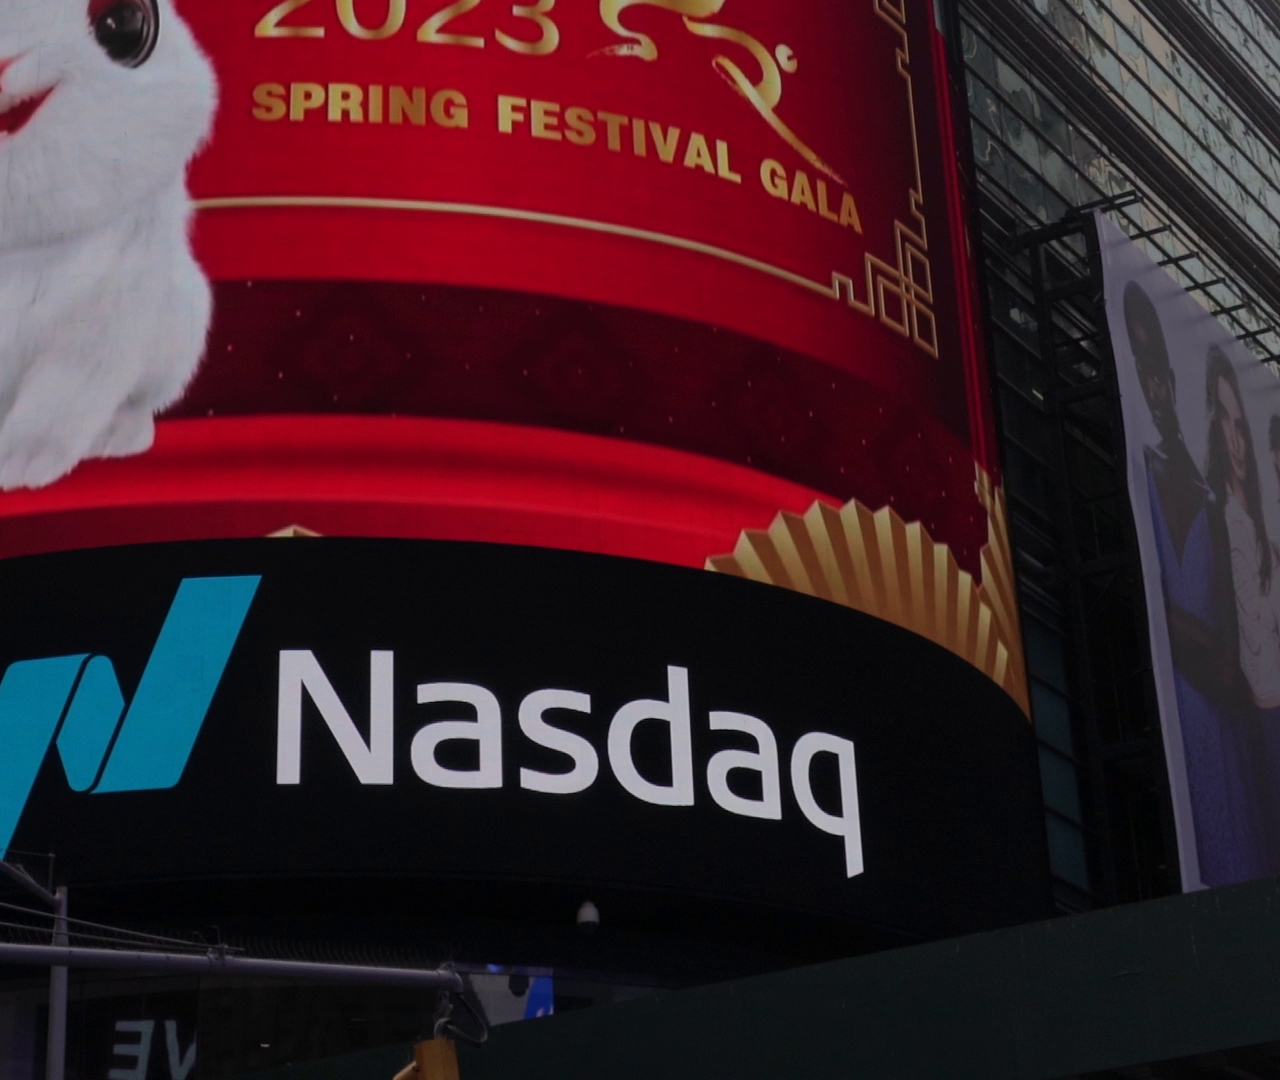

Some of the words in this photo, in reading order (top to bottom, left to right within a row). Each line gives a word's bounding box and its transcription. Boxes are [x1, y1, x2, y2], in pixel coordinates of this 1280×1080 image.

[252, 82, 469, 129] SPRING
[497, 94, 742, 184] FESTIVAL
[759, 158, 863, 235] GALA
[276, 649, 864, 879] Nasdaq
